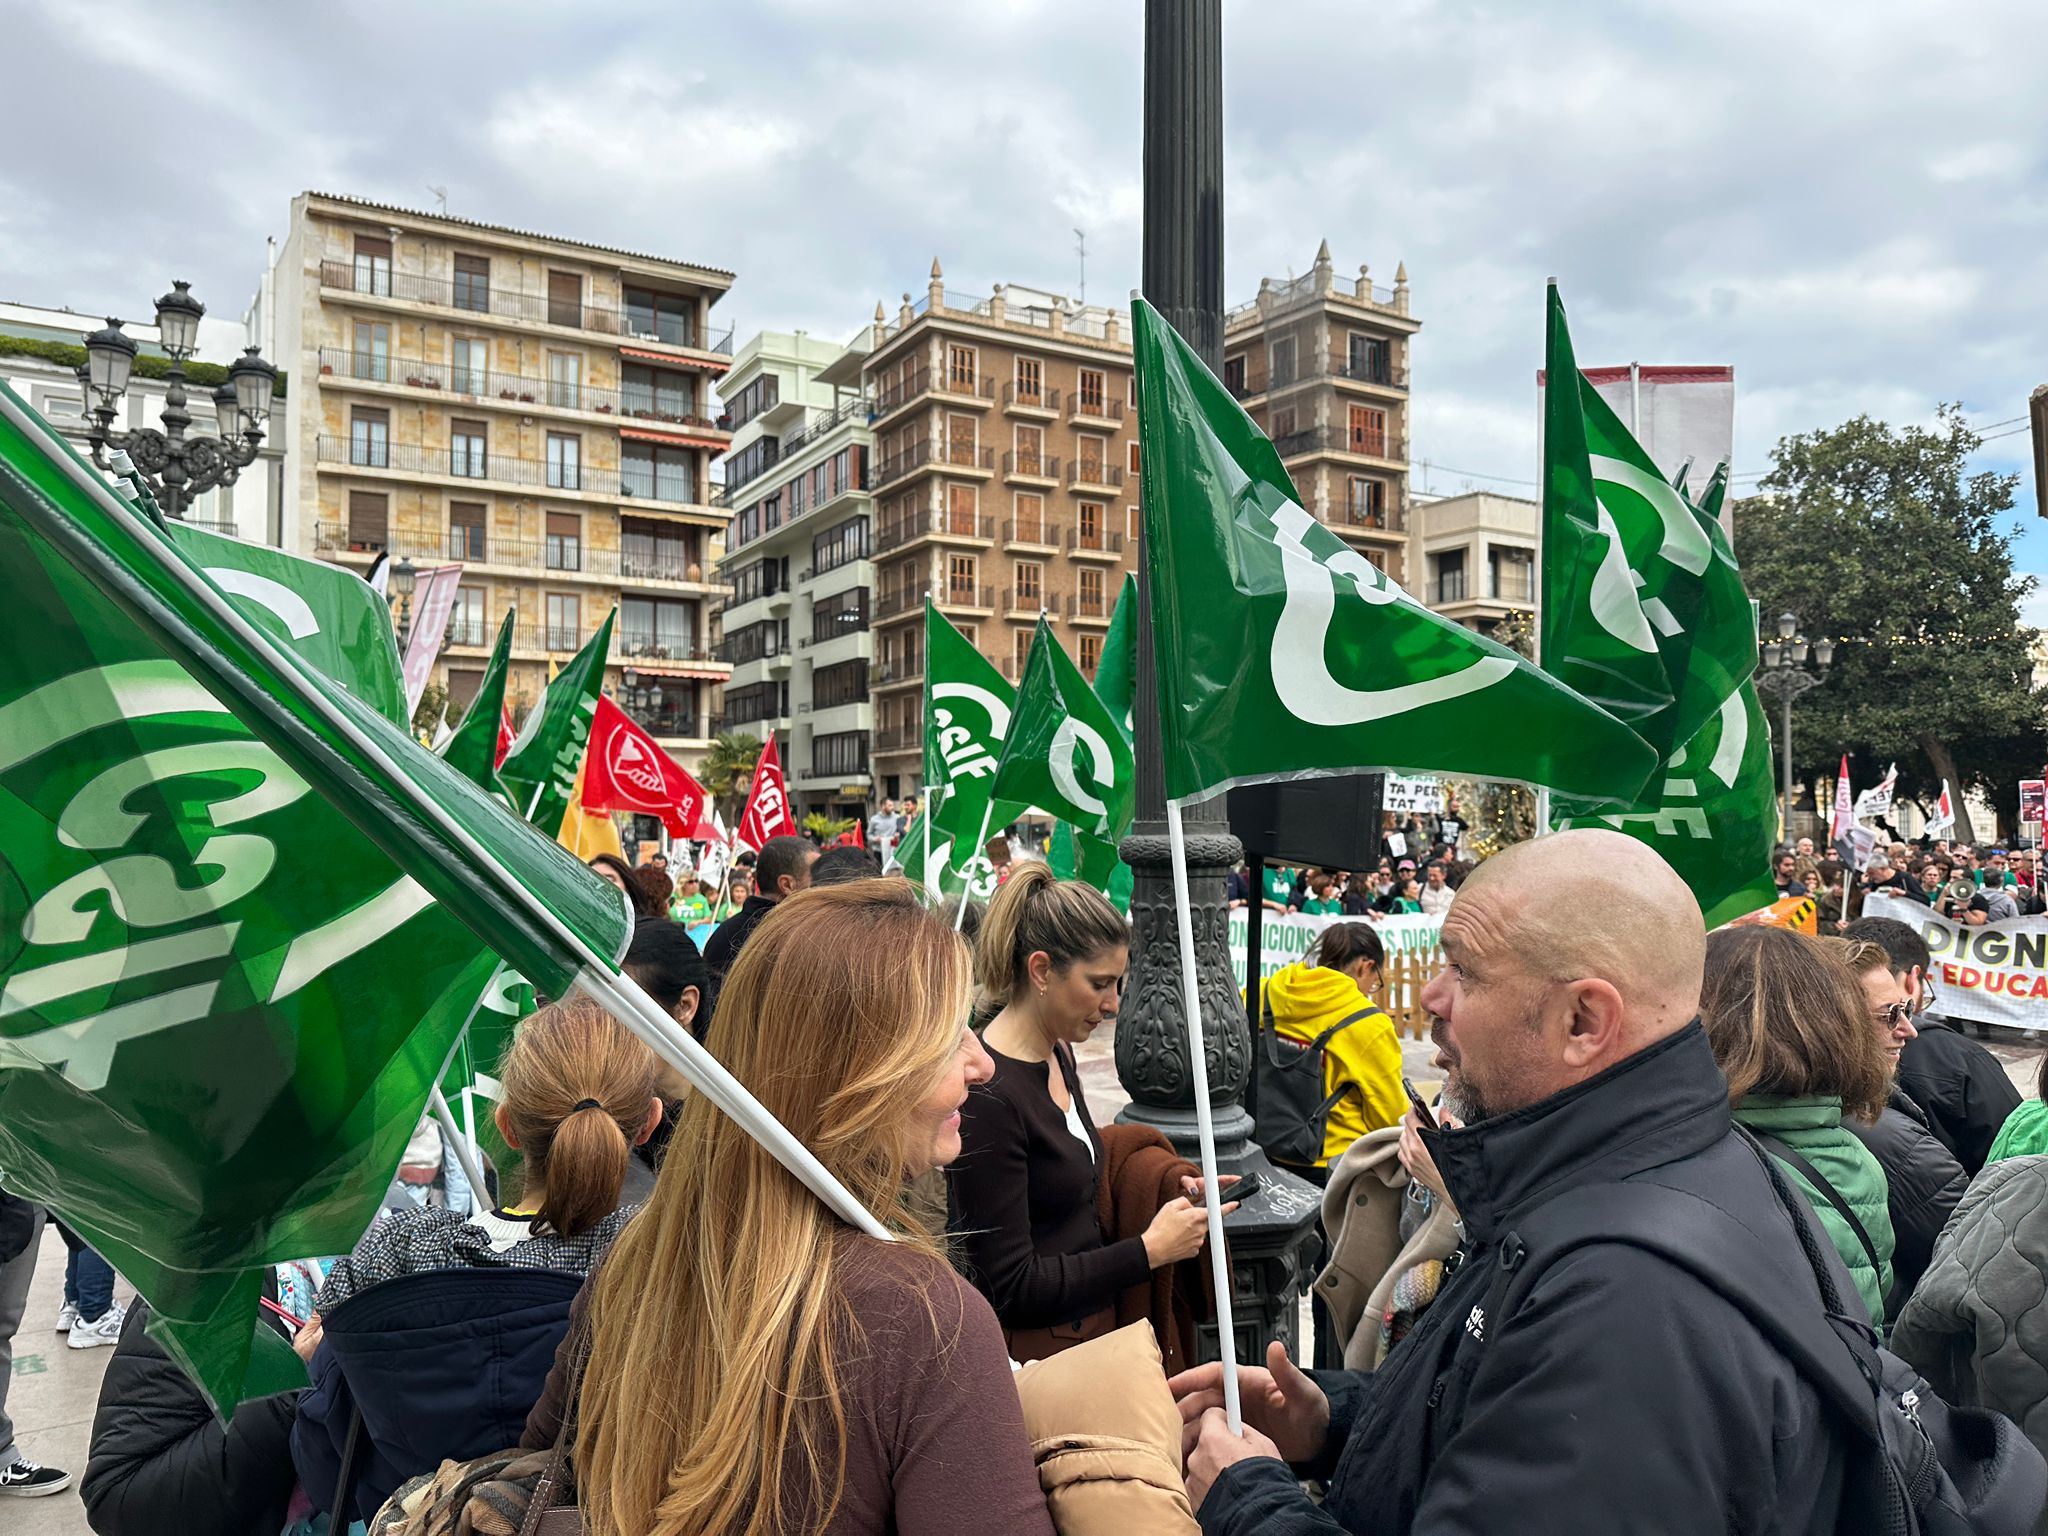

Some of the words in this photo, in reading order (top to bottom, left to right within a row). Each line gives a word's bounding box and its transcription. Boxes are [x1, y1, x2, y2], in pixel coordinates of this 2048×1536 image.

[1389, 783, 1406, 794] TA
[1388, 798, 1416, 809] TAT
[1229, 920, 1317, 955] ONICIONS
[1922, 920, 2047, 969] DIGN
